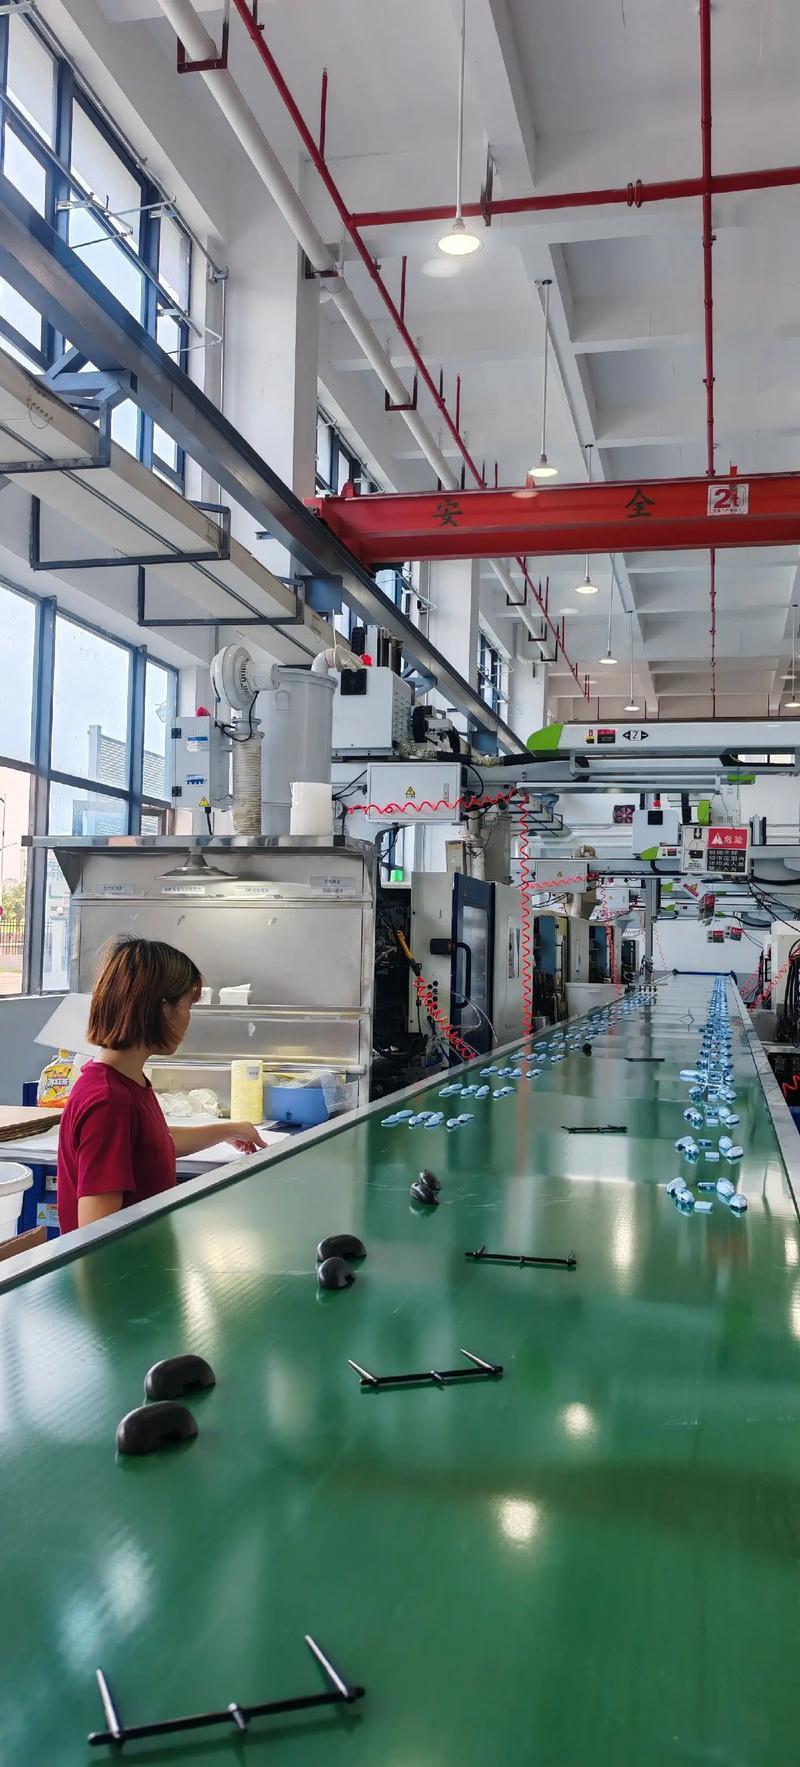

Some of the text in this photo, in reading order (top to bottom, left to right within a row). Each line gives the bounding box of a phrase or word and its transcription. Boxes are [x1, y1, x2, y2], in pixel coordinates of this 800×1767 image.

[432, 486, 656, 527] 安 全
[724, 835, 743, 845] 危险
